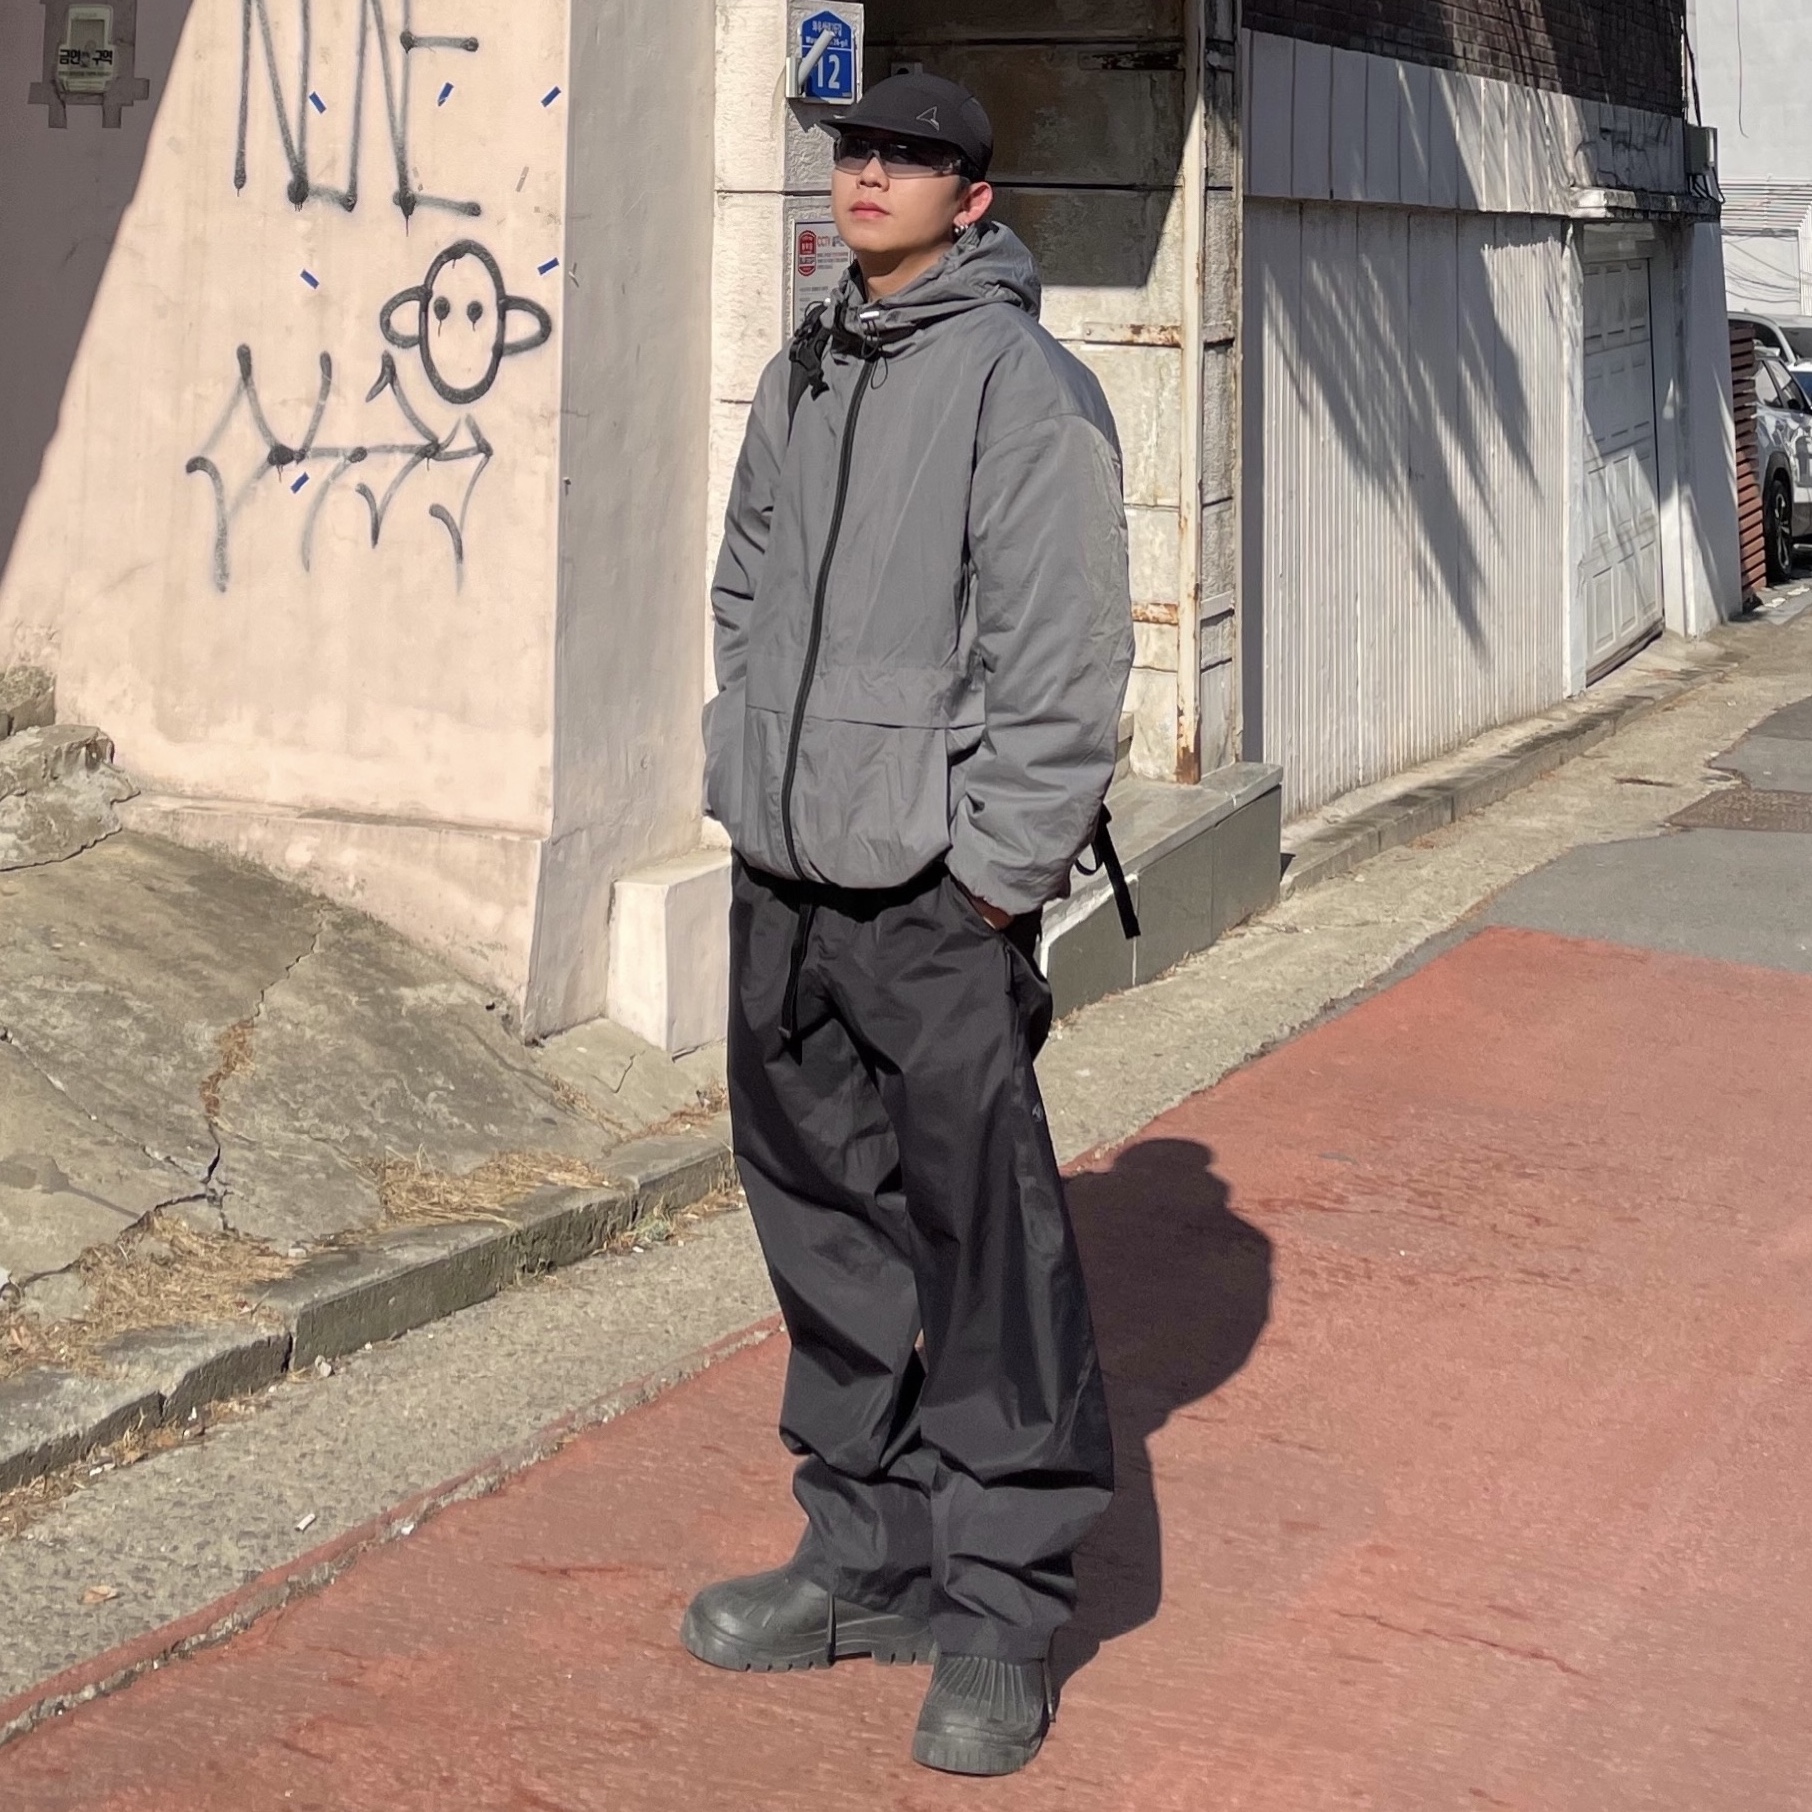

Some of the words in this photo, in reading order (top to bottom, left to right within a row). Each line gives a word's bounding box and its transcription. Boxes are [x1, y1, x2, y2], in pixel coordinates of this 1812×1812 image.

[59, 49, 81, 65] 금연
[92, 49, 113, 66] 구역
[817, 54, 840, 90] 12
